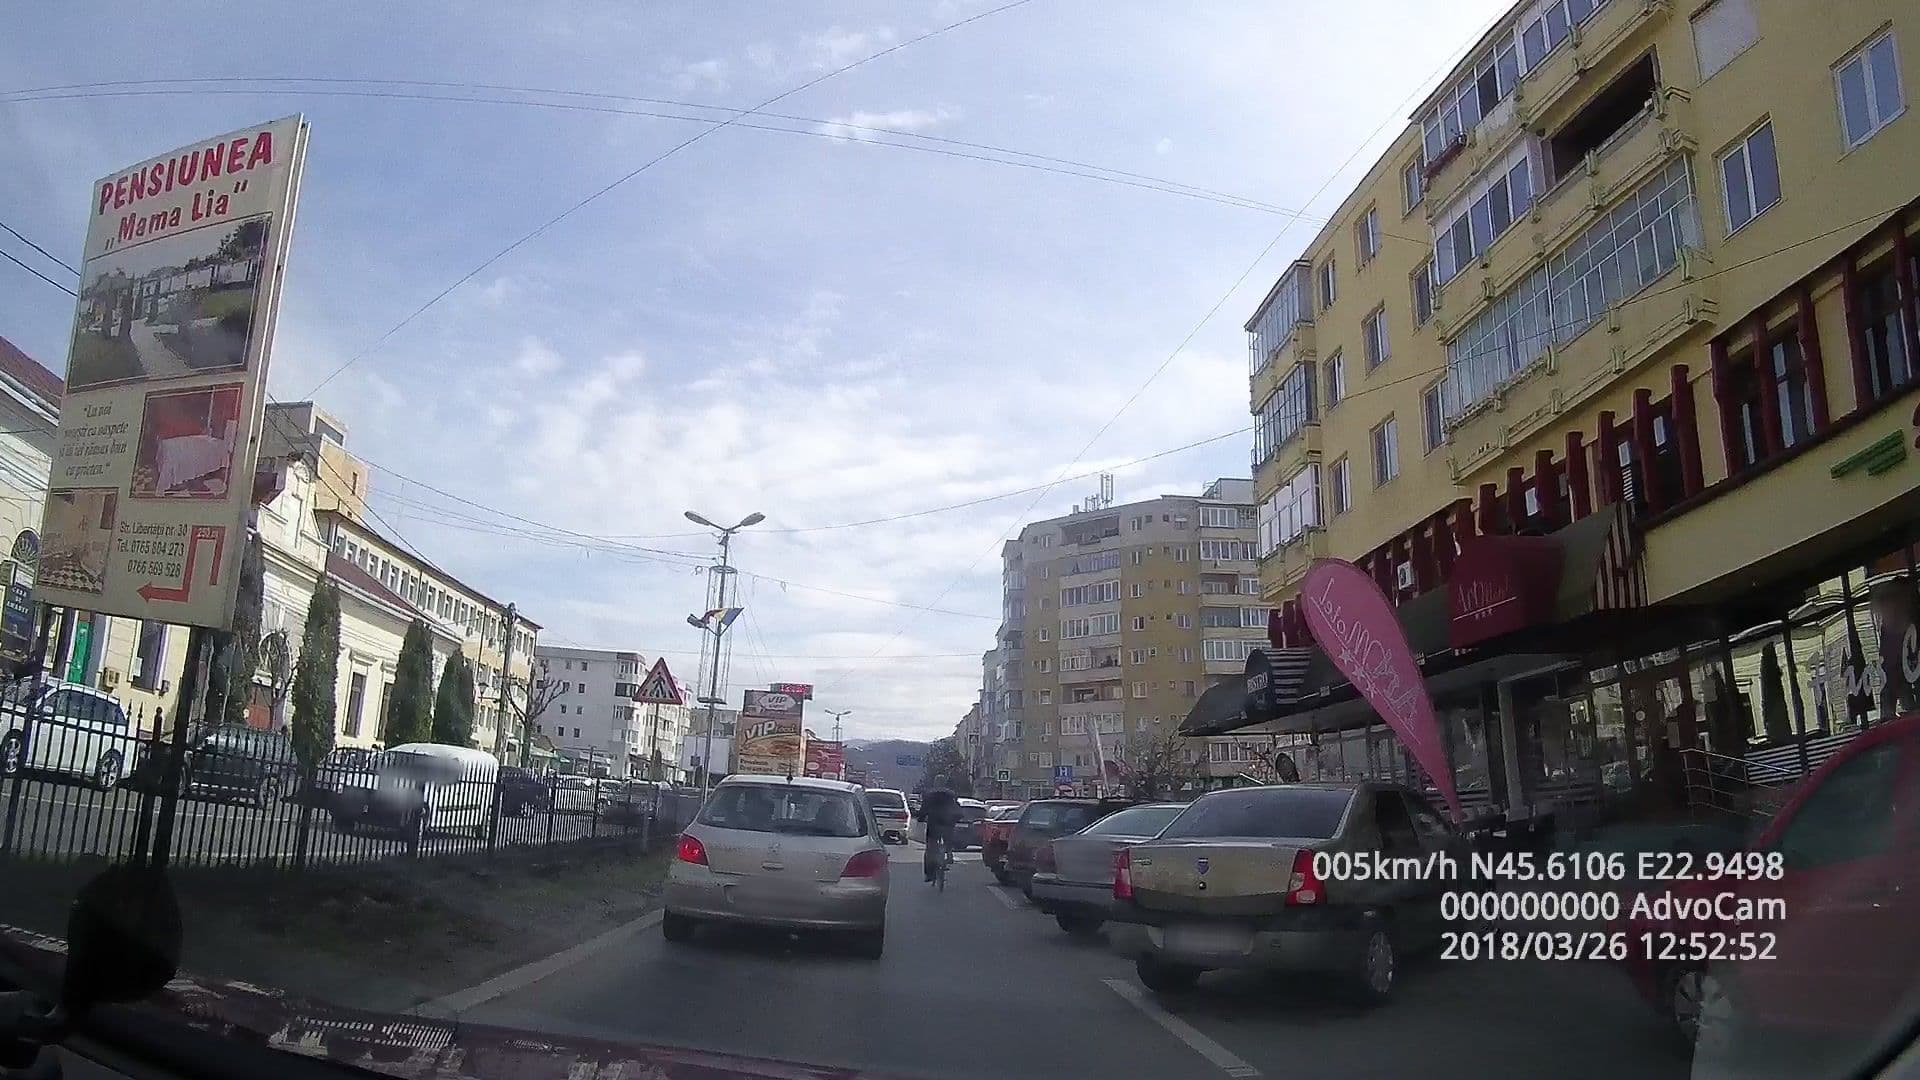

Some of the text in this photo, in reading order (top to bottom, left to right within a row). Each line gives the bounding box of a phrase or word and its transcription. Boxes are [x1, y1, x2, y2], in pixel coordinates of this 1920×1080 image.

[99, 132, 272, 215] PENSIUNEA
[177, 523, 188, 537] 30
[167, 542, 185, 557] 273
[1247, 672, 1269, 695] BISTRO
[768, 696, 787, 704] VIP
[745, 720, 776, 740] VIP
